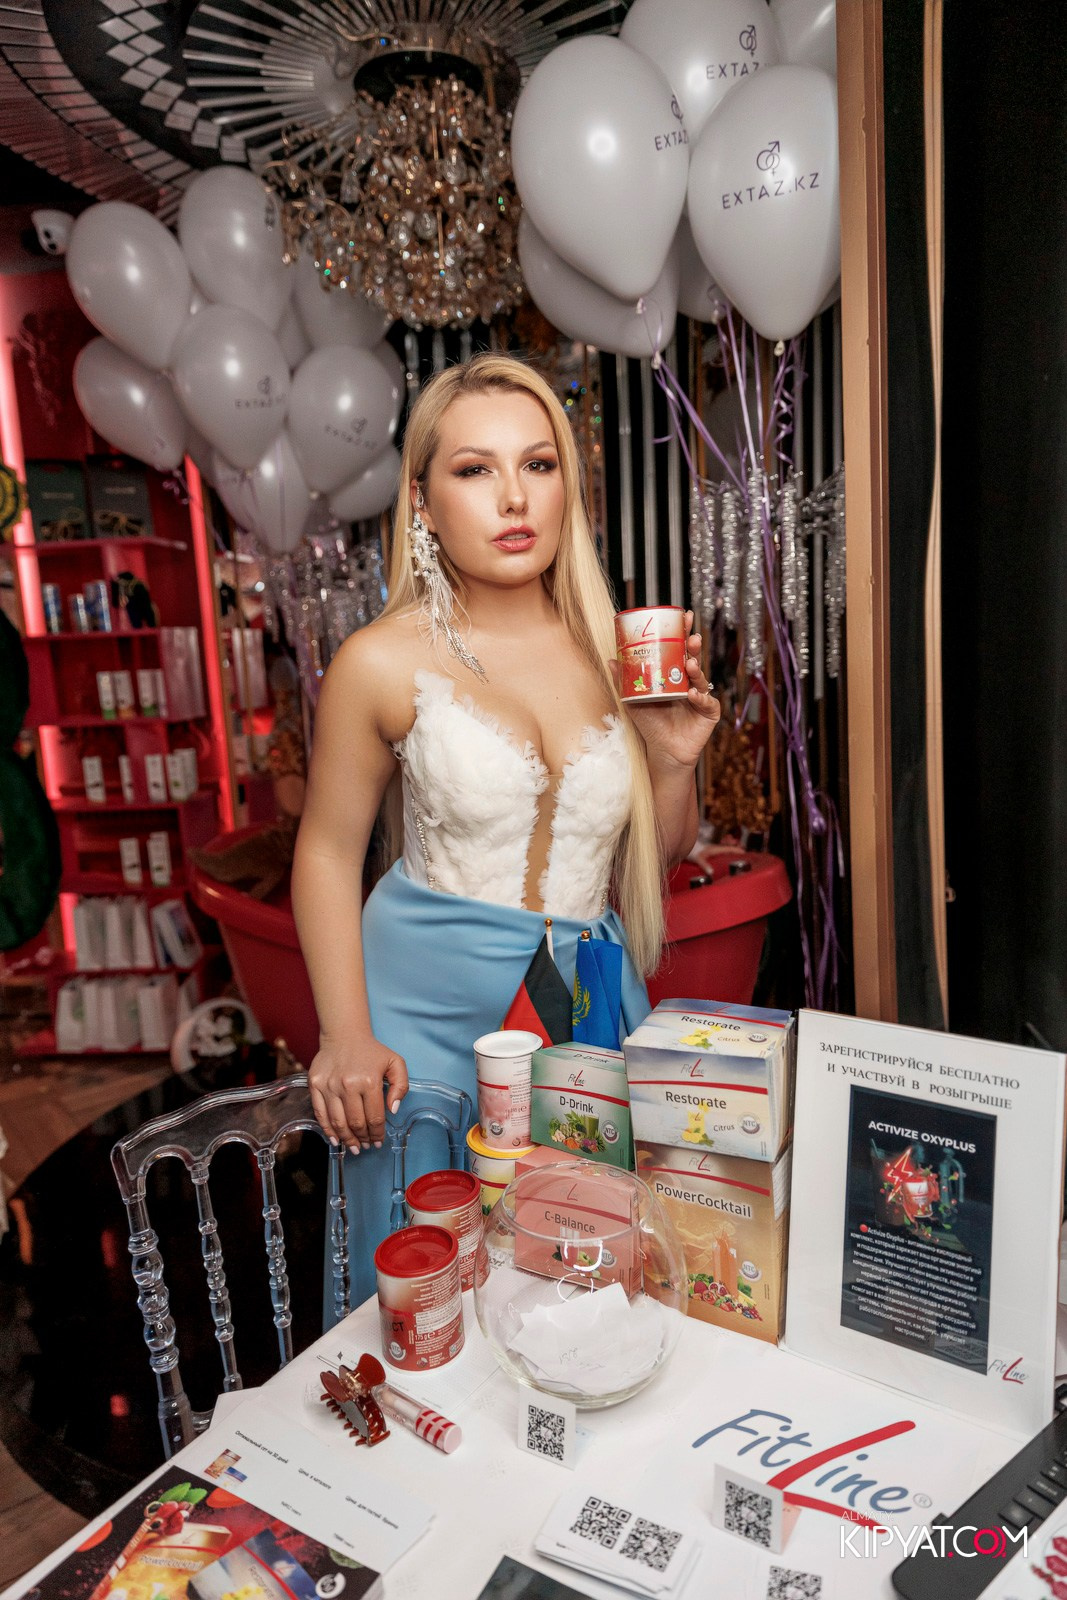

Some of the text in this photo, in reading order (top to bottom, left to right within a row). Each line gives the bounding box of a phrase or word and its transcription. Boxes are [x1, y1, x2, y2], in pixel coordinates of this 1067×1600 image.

[722, 172, 820, 210] EXTAZ.KZ
[681, 1015, 741, 1033] Restorate
[819, 1042, 1020, 1090] ЗАРЕГИСТРИРУЙСЯ БЕСПЛАТНО
[665, 1091, 727, 1110] Restorate
[827, 1062, 1013, 1110] И УЧАСТВУЙ В РОЗЫГРЫШЕ
[559, 1095, 594, 1114] D-Drink
[713, 1123, 735, 1132] Citrus
[868, 1120, 977, 1154] ACTIVIZE OXYPLUS
[656, 1182, 751, 1218] PowerCocktail
[544, 1210, 597, 1234] C-Balance
